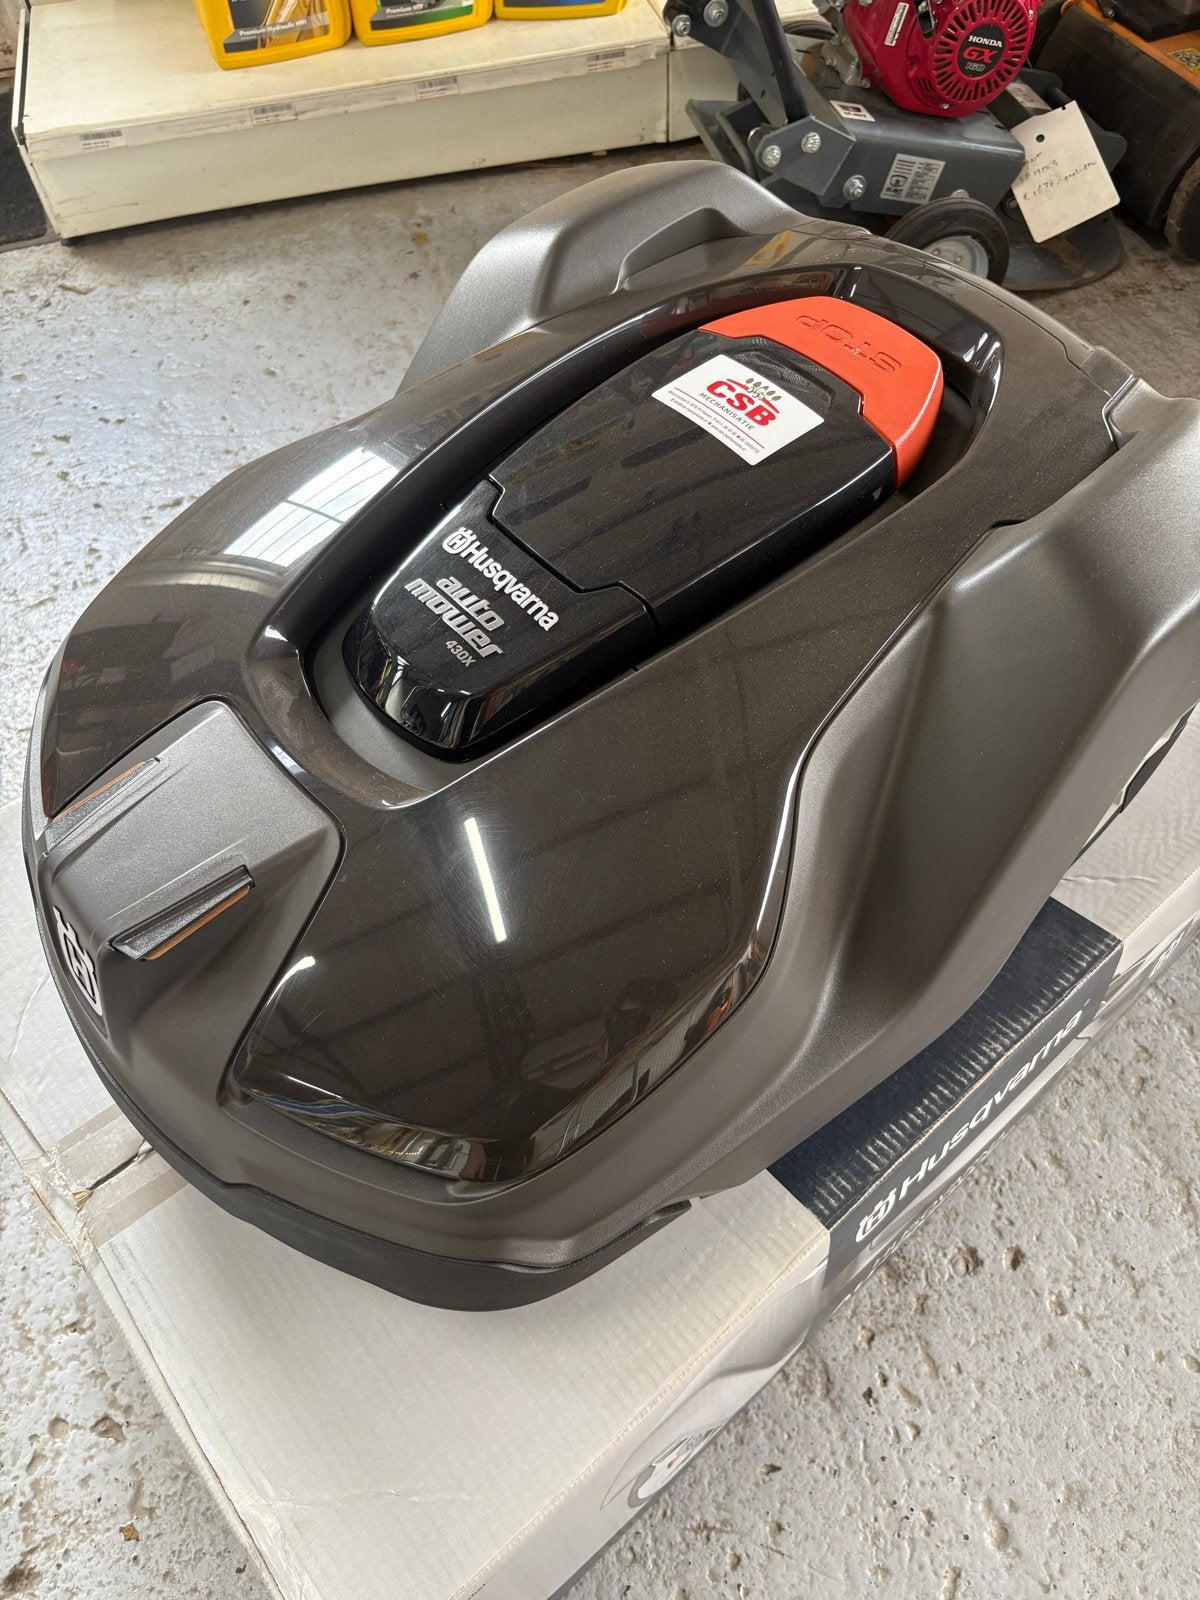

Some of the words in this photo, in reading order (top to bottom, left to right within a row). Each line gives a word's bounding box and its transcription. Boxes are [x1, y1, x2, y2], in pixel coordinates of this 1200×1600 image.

[239, 27, 267, 37] Premium
[267, 22, 295, 33] Hydraulic
[967, 35, 1003, 48] HONDA
[963, 46, 998, 63] GX
[794, 314, 903, 374] STOP
[698, 392, 756, 431] MECHANISATIE
[706, 380, 777, 427] CSB
[436, 576, 505, 632] auto
[460, 540, 559, 632] Husqvarna
[404, 578, 504, 659] mower
[445, 640, 477, 667] 430X
[898, 1009, 1083, 1201] Husqvarna
